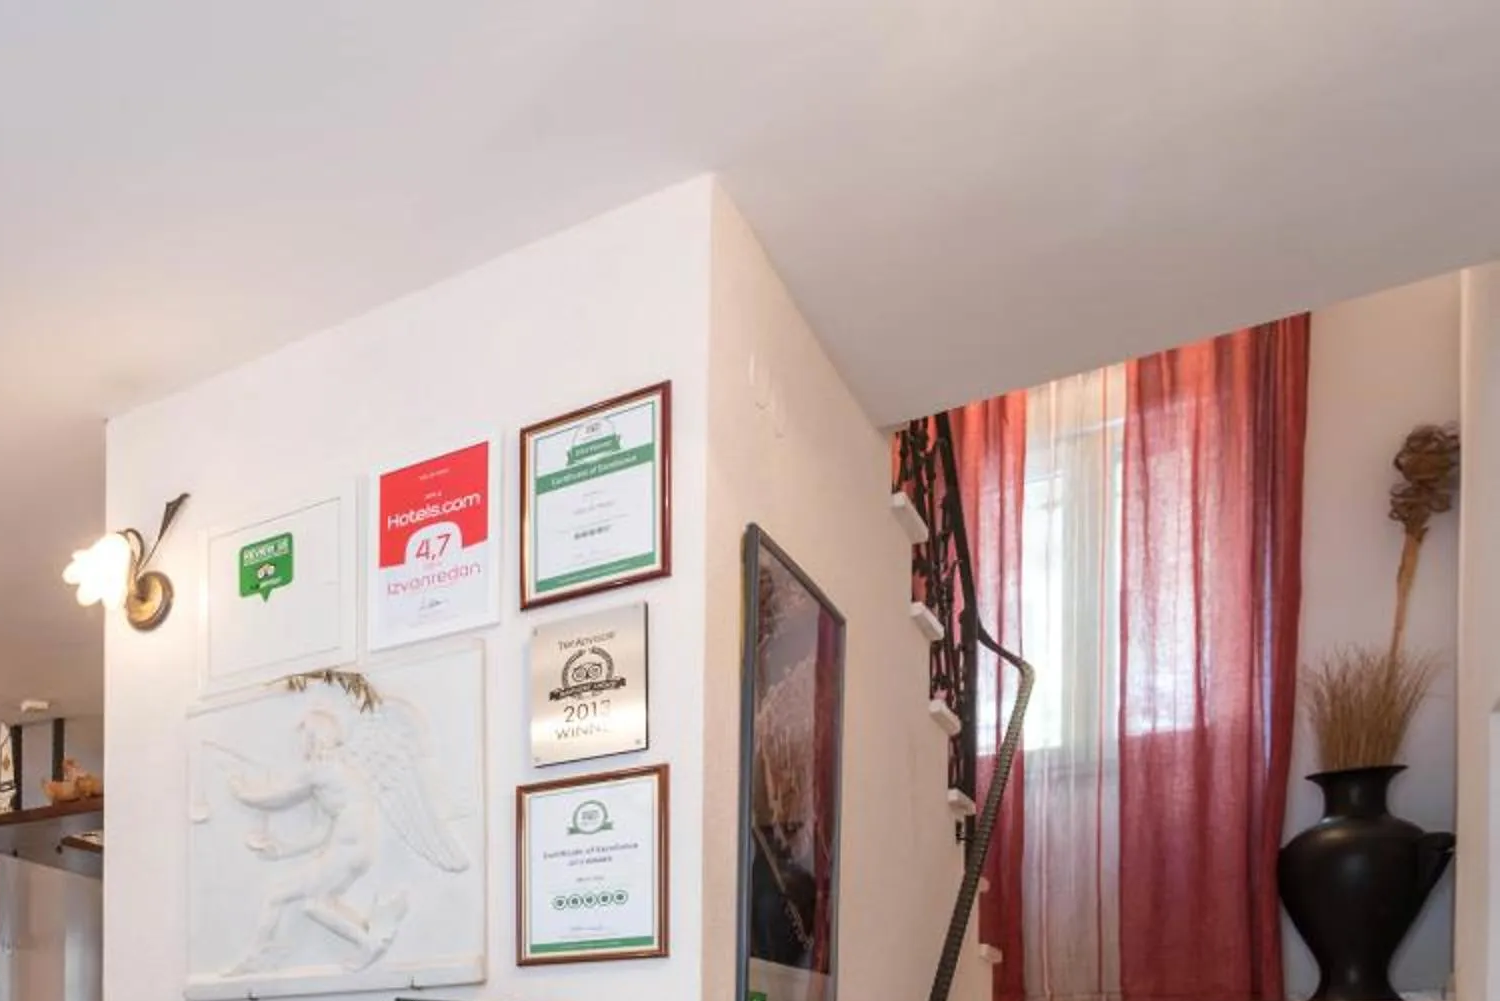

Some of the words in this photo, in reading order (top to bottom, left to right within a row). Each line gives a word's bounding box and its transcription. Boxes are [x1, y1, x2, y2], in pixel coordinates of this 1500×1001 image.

[387, 492, 481, 531] Hotels.com
[415, 533, 452, 561] 4,7
[387, 561, 482, 595] Izvanredan
